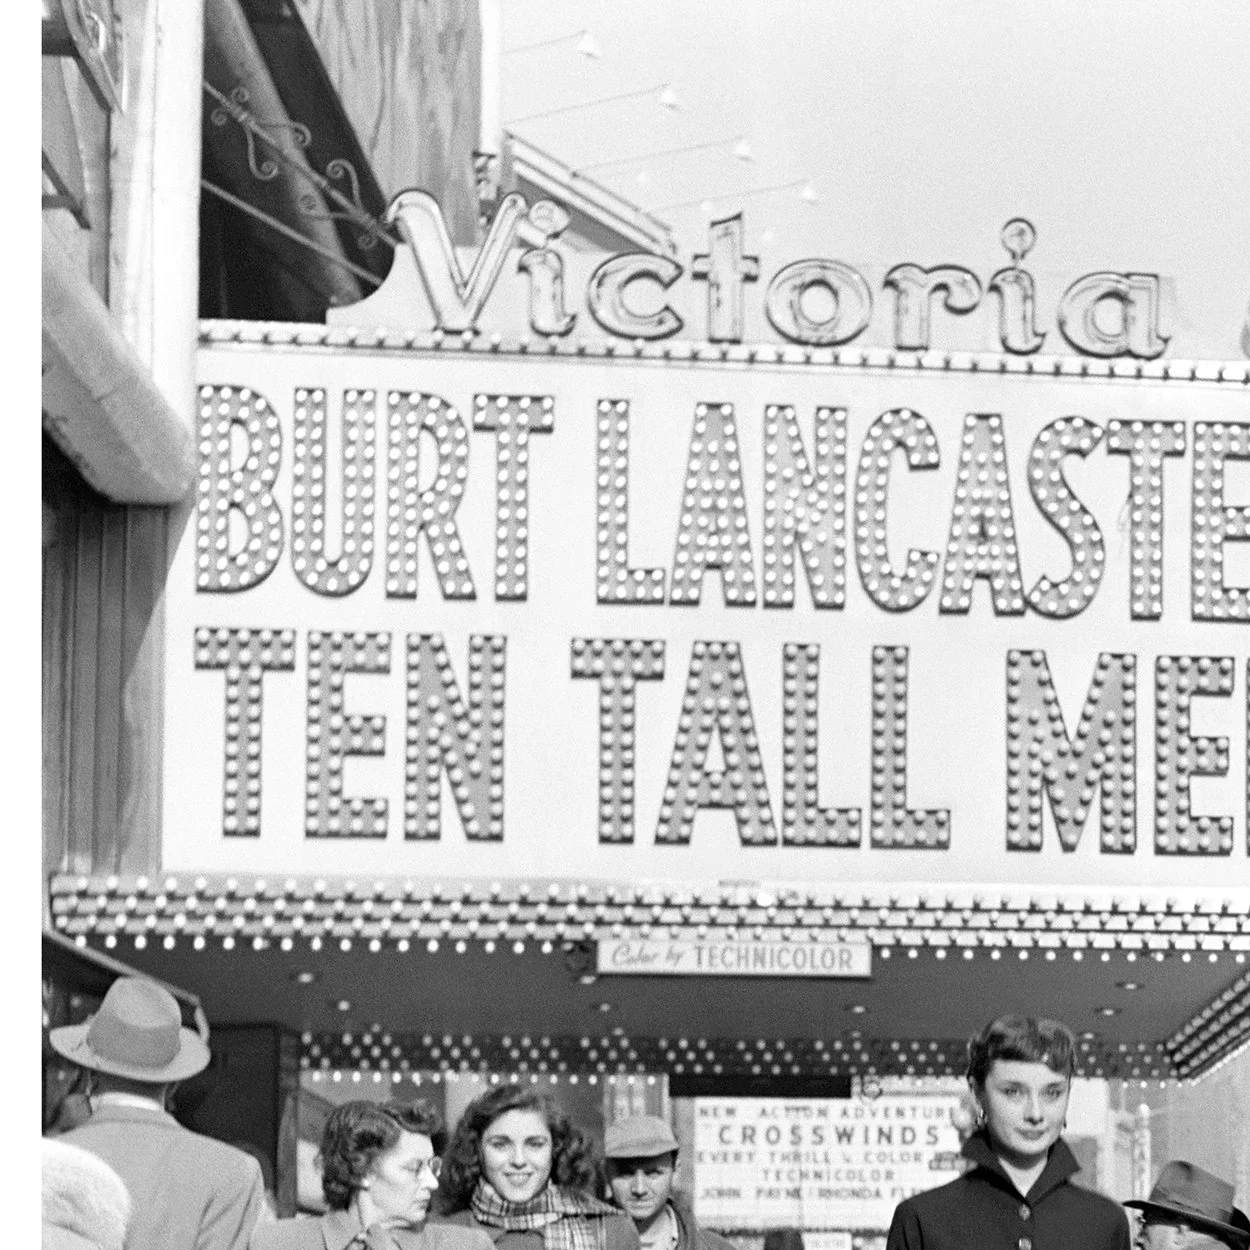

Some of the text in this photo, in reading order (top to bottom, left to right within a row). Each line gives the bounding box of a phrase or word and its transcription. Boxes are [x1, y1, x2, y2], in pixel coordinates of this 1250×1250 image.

[385, 188, 1173, 361] Victoria
[194, 383, 555, 602] BURT
[194, 626, 508, 843] TEN
[570, 637, 951, 853] TALL
[694, 945, 854, 971] TECHNICOLOR
[699, 1106, 736, 1118] NEW
[698, 1150, 755, 1163] EVERY
[769, 1150, 831, 1164] THRILL
[864, 1150, 922, 1163] COLOR
[762, 1168, 894, 1182] TECHNICOLOR
